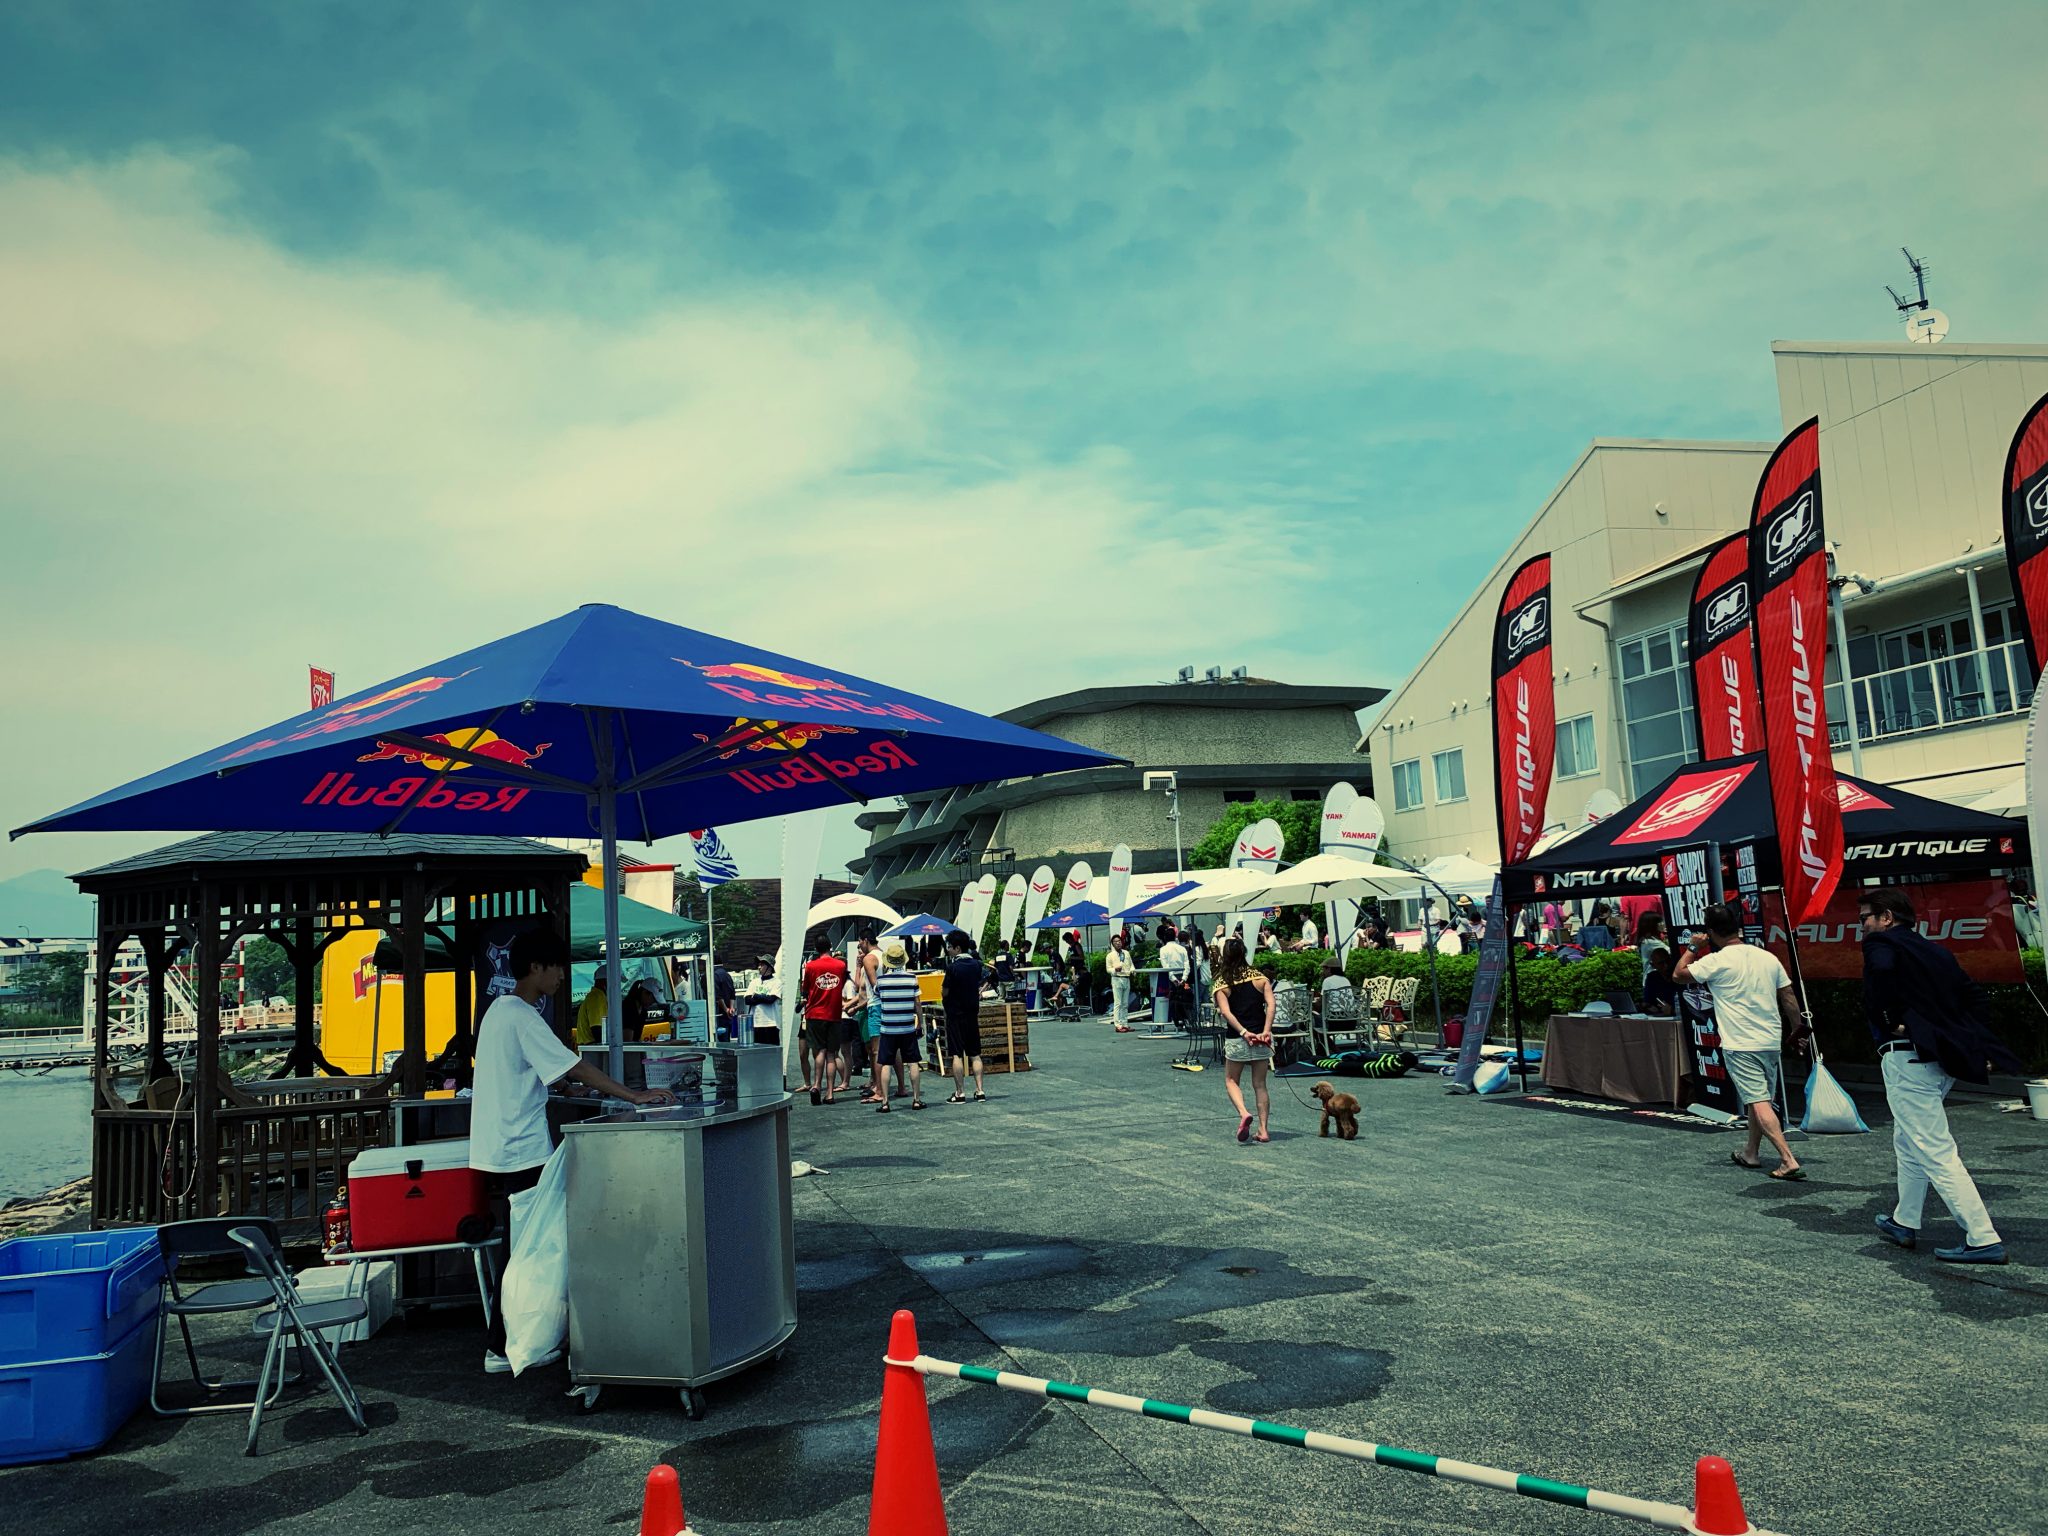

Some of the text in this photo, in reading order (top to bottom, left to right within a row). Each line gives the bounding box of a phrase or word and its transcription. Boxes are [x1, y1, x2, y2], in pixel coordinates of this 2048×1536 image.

[1721, 655, 1745, 756] IQUE
[1341, 831, 1377, 840] YANMAR
[1676, 850, 1707, 885] SIMPLY
[1665, 883, 1709, 927] THE BEST
[1768, 918, 1990, 943] NAUTUE
